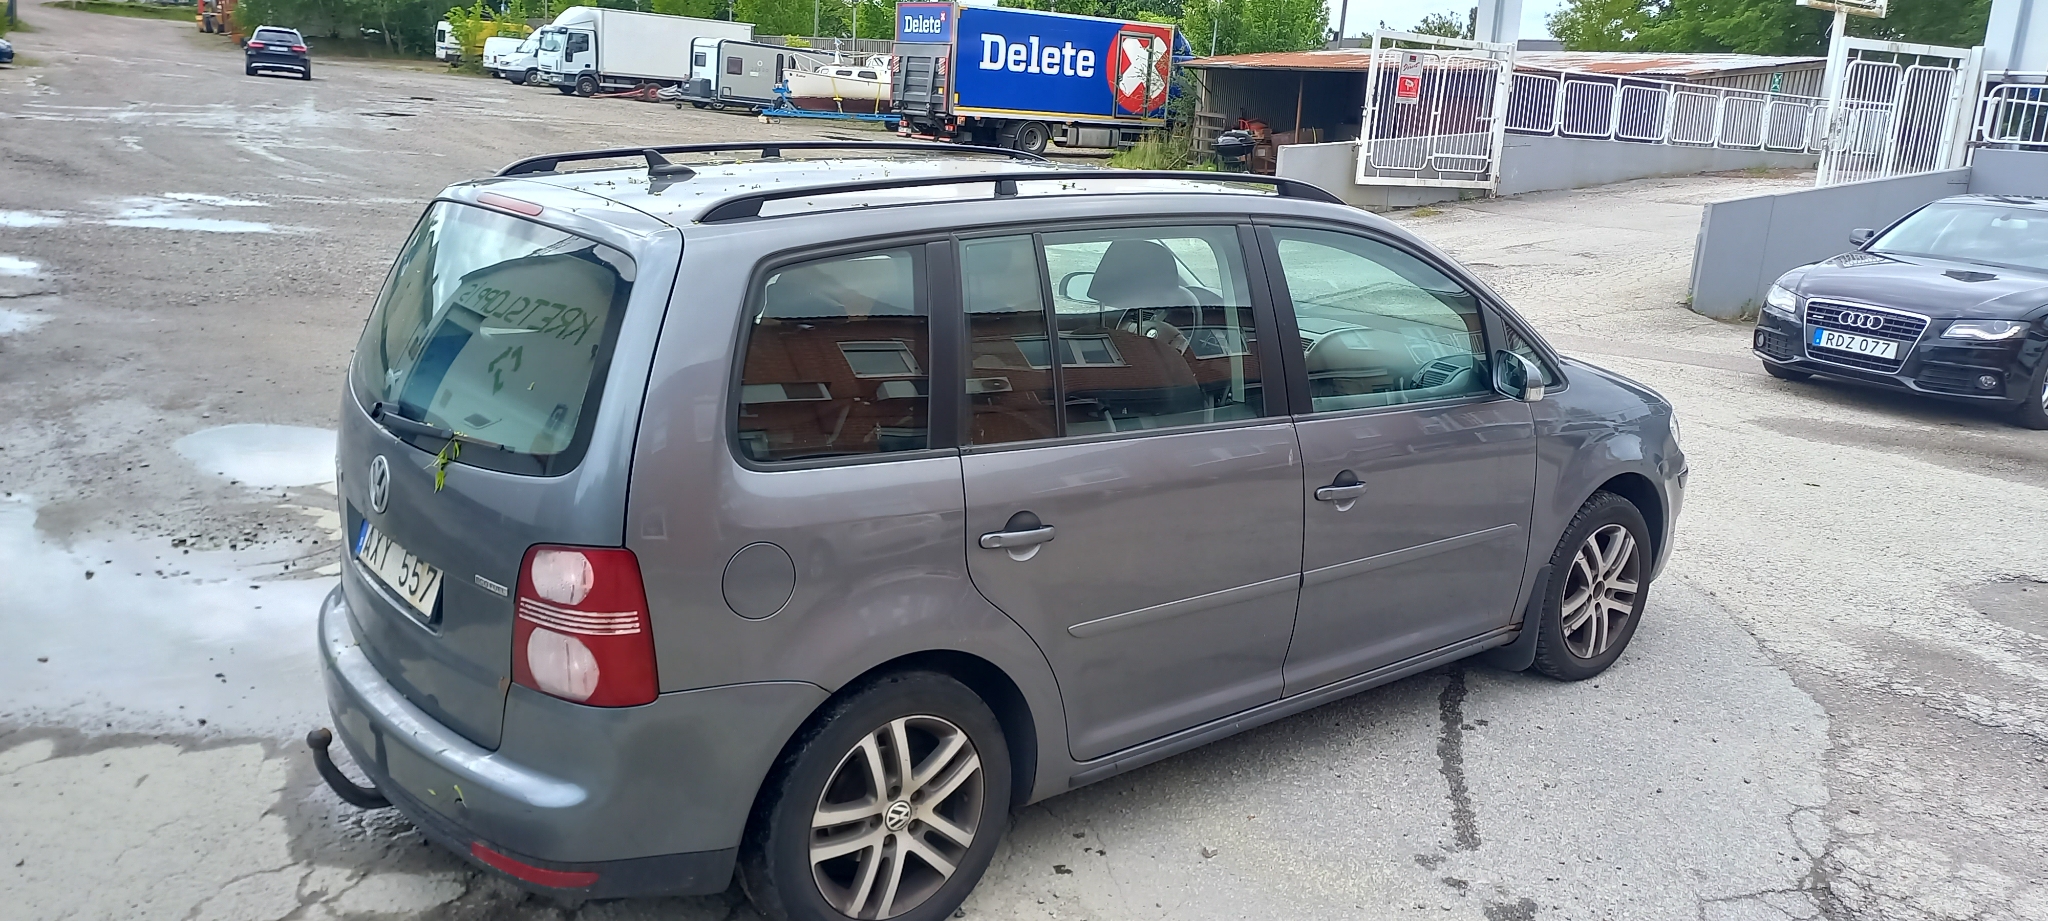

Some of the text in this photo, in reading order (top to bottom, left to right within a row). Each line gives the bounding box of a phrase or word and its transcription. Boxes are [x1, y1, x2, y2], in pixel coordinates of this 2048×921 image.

[903, 15, 942, 34] Delete
[979, 33, 1095, 78] Delete
[1825, 332, 1890, 355] RDZ 077
[362, 526, 438, 603] AXY 557
